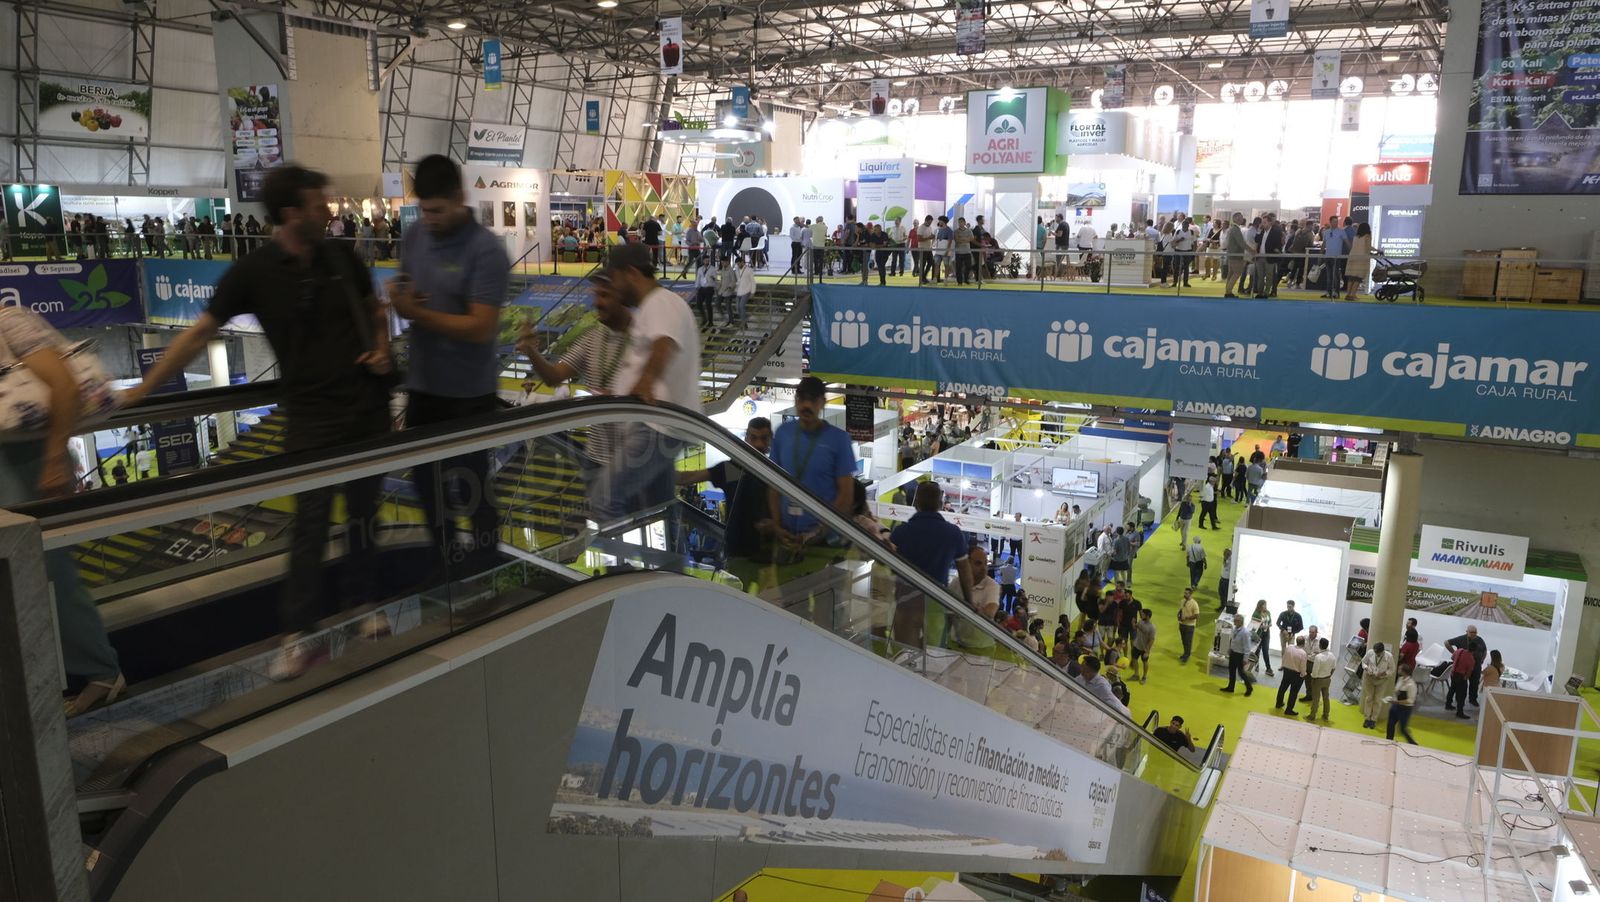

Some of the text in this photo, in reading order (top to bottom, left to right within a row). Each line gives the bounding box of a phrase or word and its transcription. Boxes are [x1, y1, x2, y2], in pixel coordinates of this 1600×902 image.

[1512, 1, 1535, 12] K+S
[1536, 0, 1570, 10] extrae
[1526, 14, 1558, 24] minas
[1499, 30, 1512, 38] en
[1514, 26, 1554, 37] abonos
[1522, 41, 1548, 51] para
[1550, 38, 1564, 48] las
[987, 138, 1019, 151] AGRI
[972, 152, 1032, 164] POLYANE
[148, 188, 179, 196] Koppert
[174, 278, 217, 304] cajam
[878, 316, 1010, 354] cajamar
[940, 350, 1006, 362] CAJA RURAL
[1104, 328, 1268, 369] cajamar
[142, 352, 165, 364] SE
[1382, 342, 1588, 389] cajamar
[1180, 365, 1260, 380] CAJA RURAL
[946, 382, 1005, 396] ADNAGRO
[1476, 384, 1577, 402] CAJA RURAL
[1184, 400, 1256, 418] ADNAGRO
[159, 432, 194, 448] SER
[1480, 426, 1570, 444] ADNAGRO
[164, 538, 192, 557] EL
[1456, 540, 1505, 556] Rivulis
[1432, 552, 1514, 572] NAANDANJAIN
[1351, 590, 1374, 598] PROBA
[626, 612, 800, 726] Amplía
[864, 700, 1070, 792] Especialistas en la financiación a medida de
[598, 708, 840, 820] horizontes
[854, 742, 936, 790] transmisión
[932, 770, 946, 800] y
[944, 773, 1006, 806] reconversión
[1006, 781, 1018, 808] de
[1017, 783, 1038, 814] fincas
[1040, 791, 1064, 818] rústicas
[1088, 778, 1112, 806] cajasur
